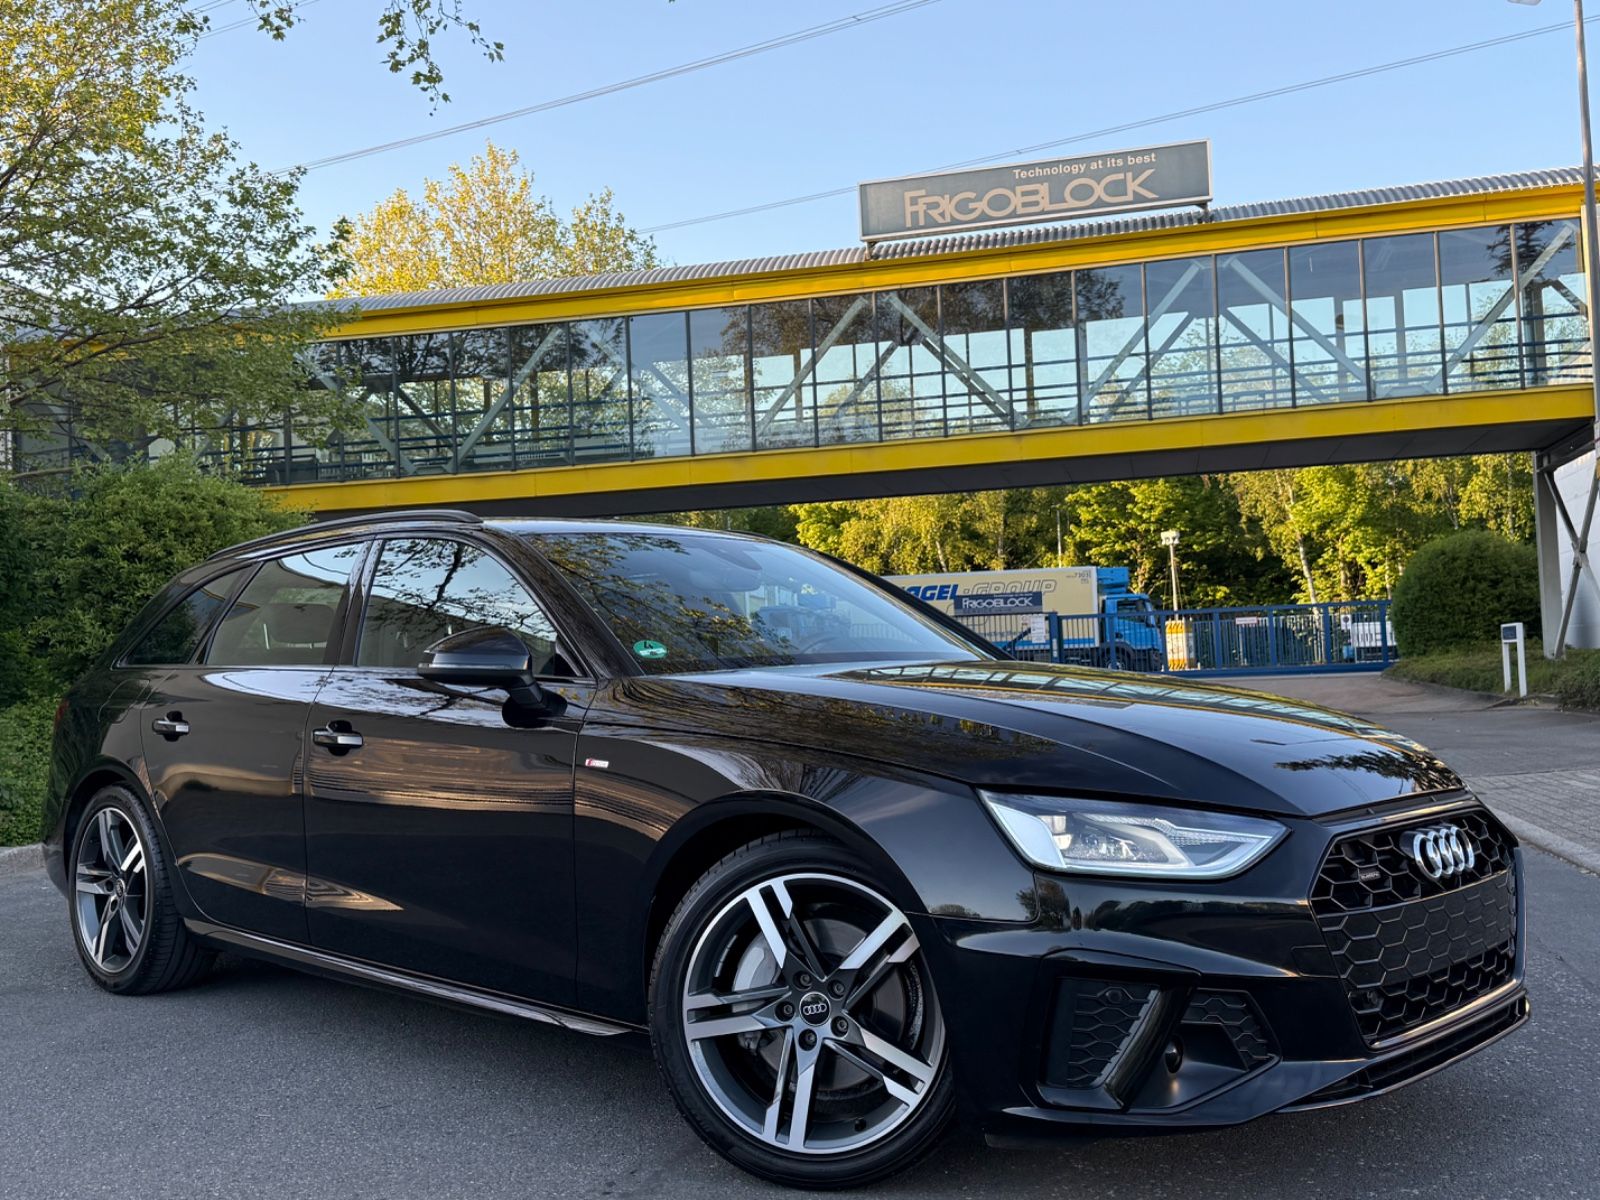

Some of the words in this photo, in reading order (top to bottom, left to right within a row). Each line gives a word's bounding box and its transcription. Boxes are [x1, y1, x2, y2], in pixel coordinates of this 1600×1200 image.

[1013, 163, 1086, 180] Technology
[1090, 159, 1102, 170] at
[1107, 156, 1124, 168] its
[1127, 152, 1156, 165] best
[904, 169, 1159, 228] FRIGOBLOCK
